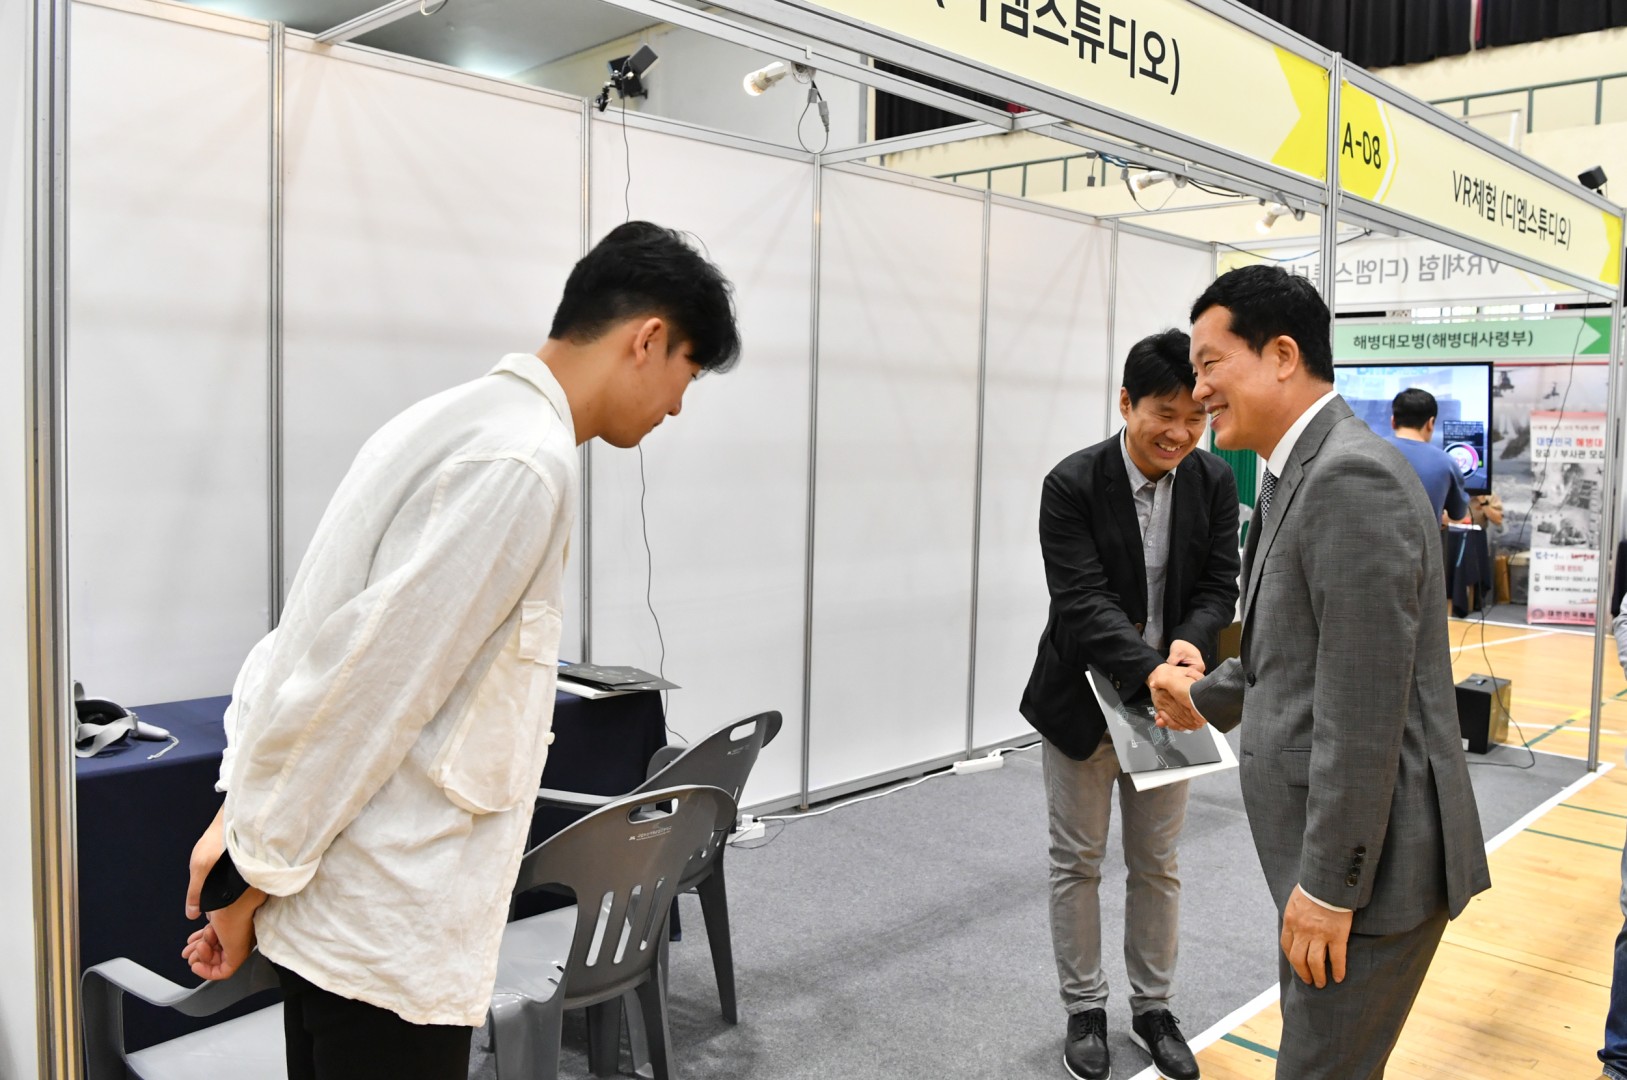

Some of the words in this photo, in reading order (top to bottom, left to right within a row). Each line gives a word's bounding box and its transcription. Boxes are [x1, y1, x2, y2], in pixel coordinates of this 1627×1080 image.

[936, 0, 1180, 95] 엠스튜디오)
[1341, 122, 1382, 169] A-08
[1453, 170, 1496, 222] VR체험
[1500, 190, 1571, 251] (디엠스튜디오)
[1353, 331, 1533, 349] 해병대모병(해병대사령부)
